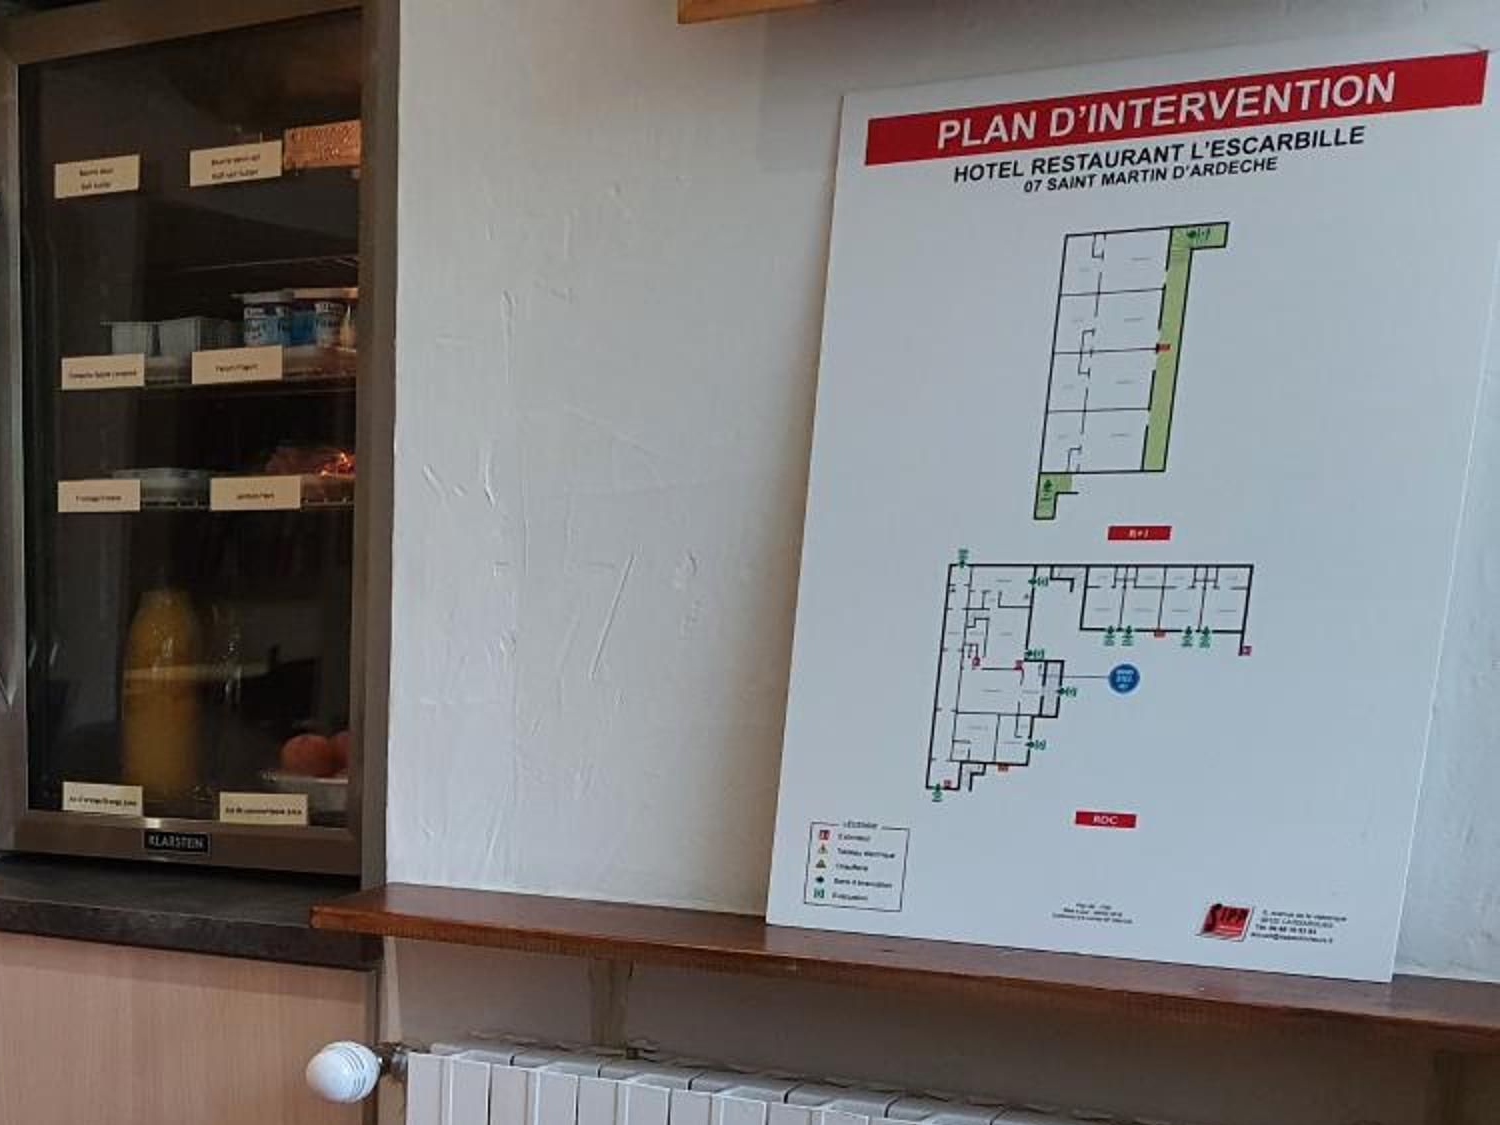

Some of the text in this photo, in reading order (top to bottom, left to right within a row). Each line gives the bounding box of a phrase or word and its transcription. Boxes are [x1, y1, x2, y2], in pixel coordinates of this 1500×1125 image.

[937, 71, 1396, 150] PLAN D'INTERVENTION
[953, 125, 1366, 184] HOTEL RESTAURANT L'ESCARBILLE
[1023, 156, 1278, 194] 07 SAINT MARTIN D'ARDECHE
[148, 833, 205, 850] KLARSTEIN
